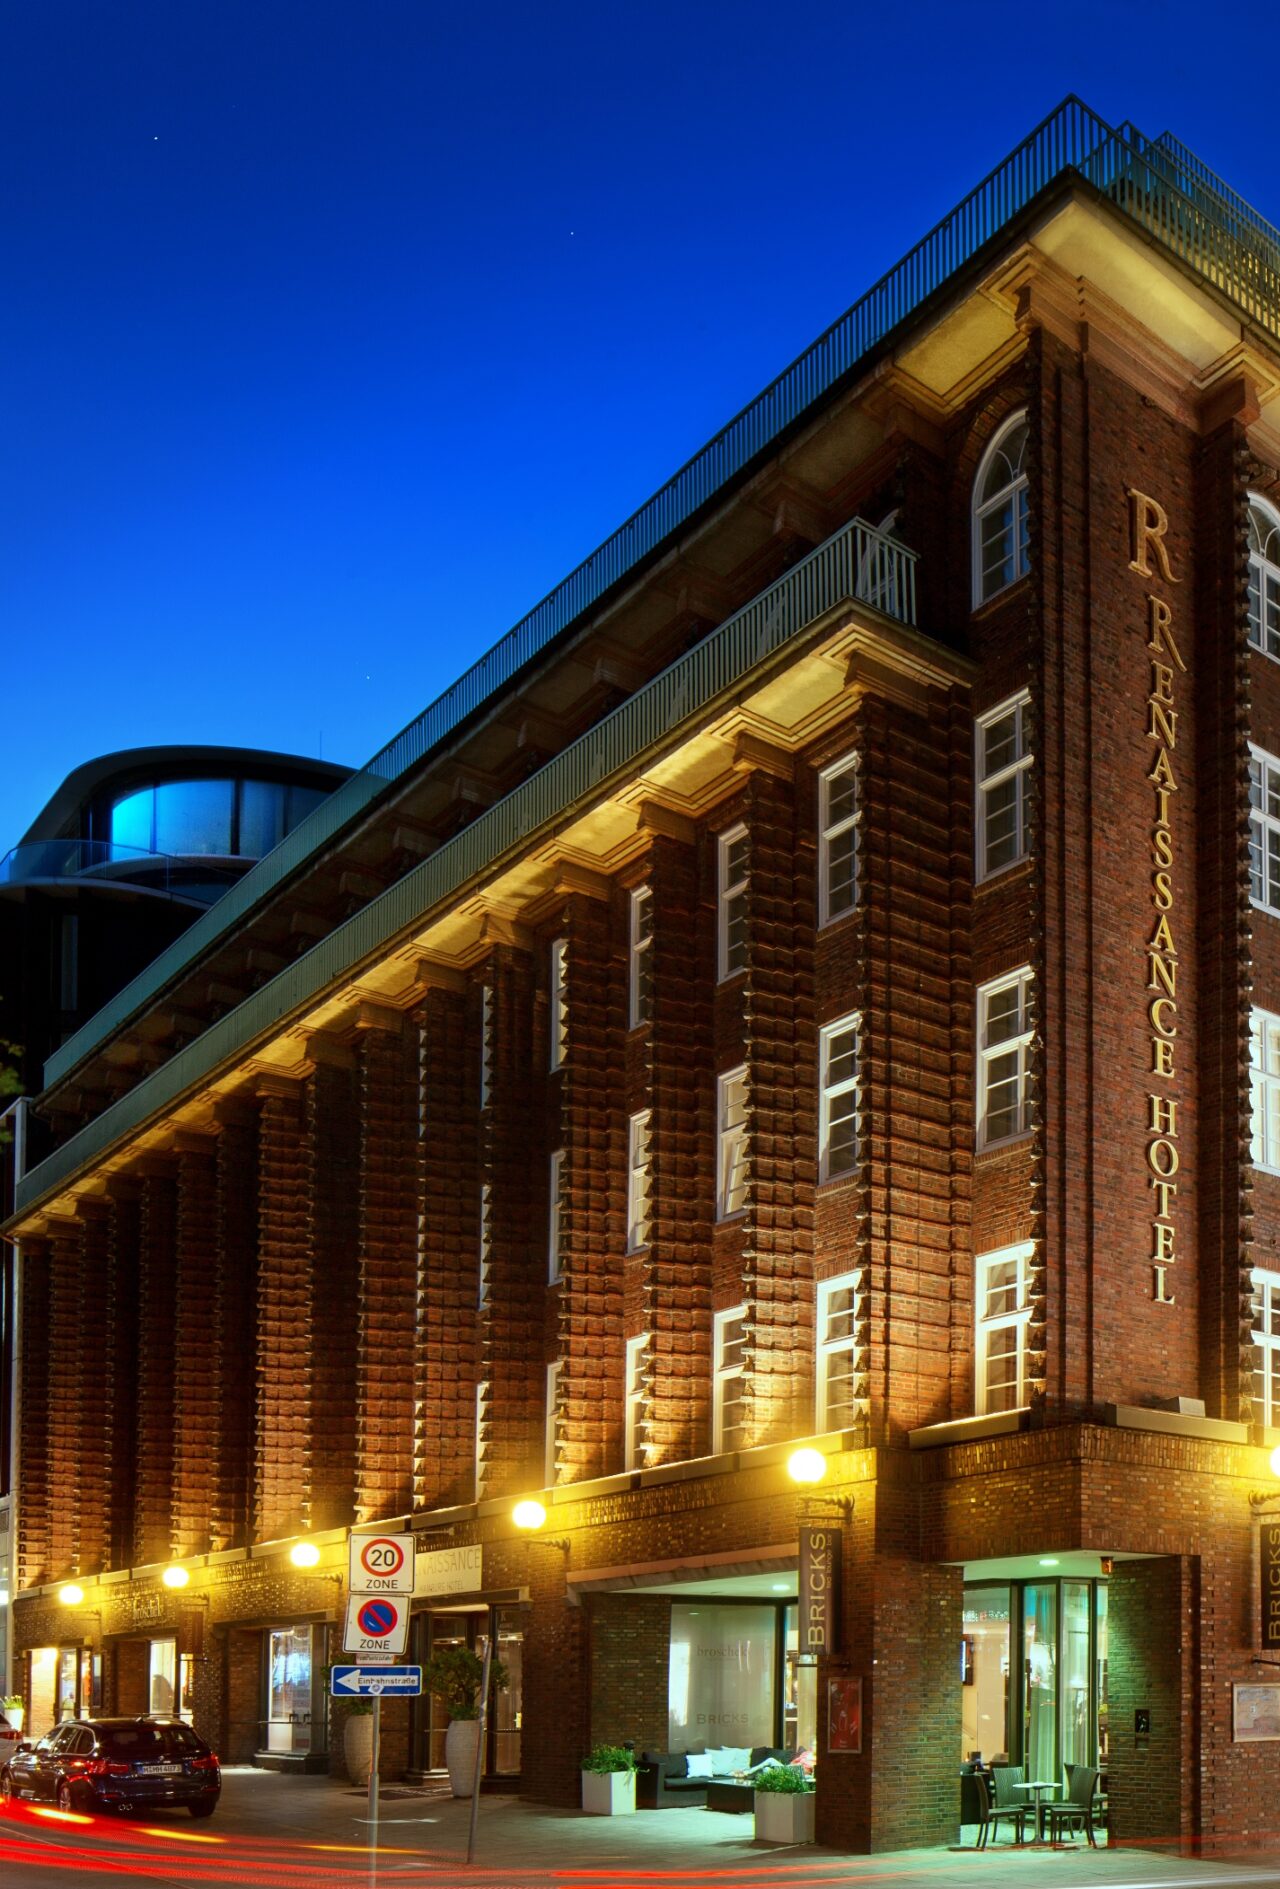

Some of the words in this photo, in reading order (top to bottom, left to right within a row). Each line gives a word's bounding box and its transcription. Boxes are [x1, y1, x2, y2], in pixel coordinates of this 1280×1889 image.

[1128, 487, 1183, 584] R
[1146, 595, 1187, 1079] RENAISSANCE
[1147, 1095, 1179, 1305] HOTEL
[370, 1549, 395, 1567] 20
[416, 1548, 480, 1577] NAISSANCE
[366, 1579, 398, 1589] ZONE
[808, 1532, 826, 1646] BRICKS
[359, 1639, 390, 1650] ZONE
[696, 1713, 749, 1725] BRICKS
